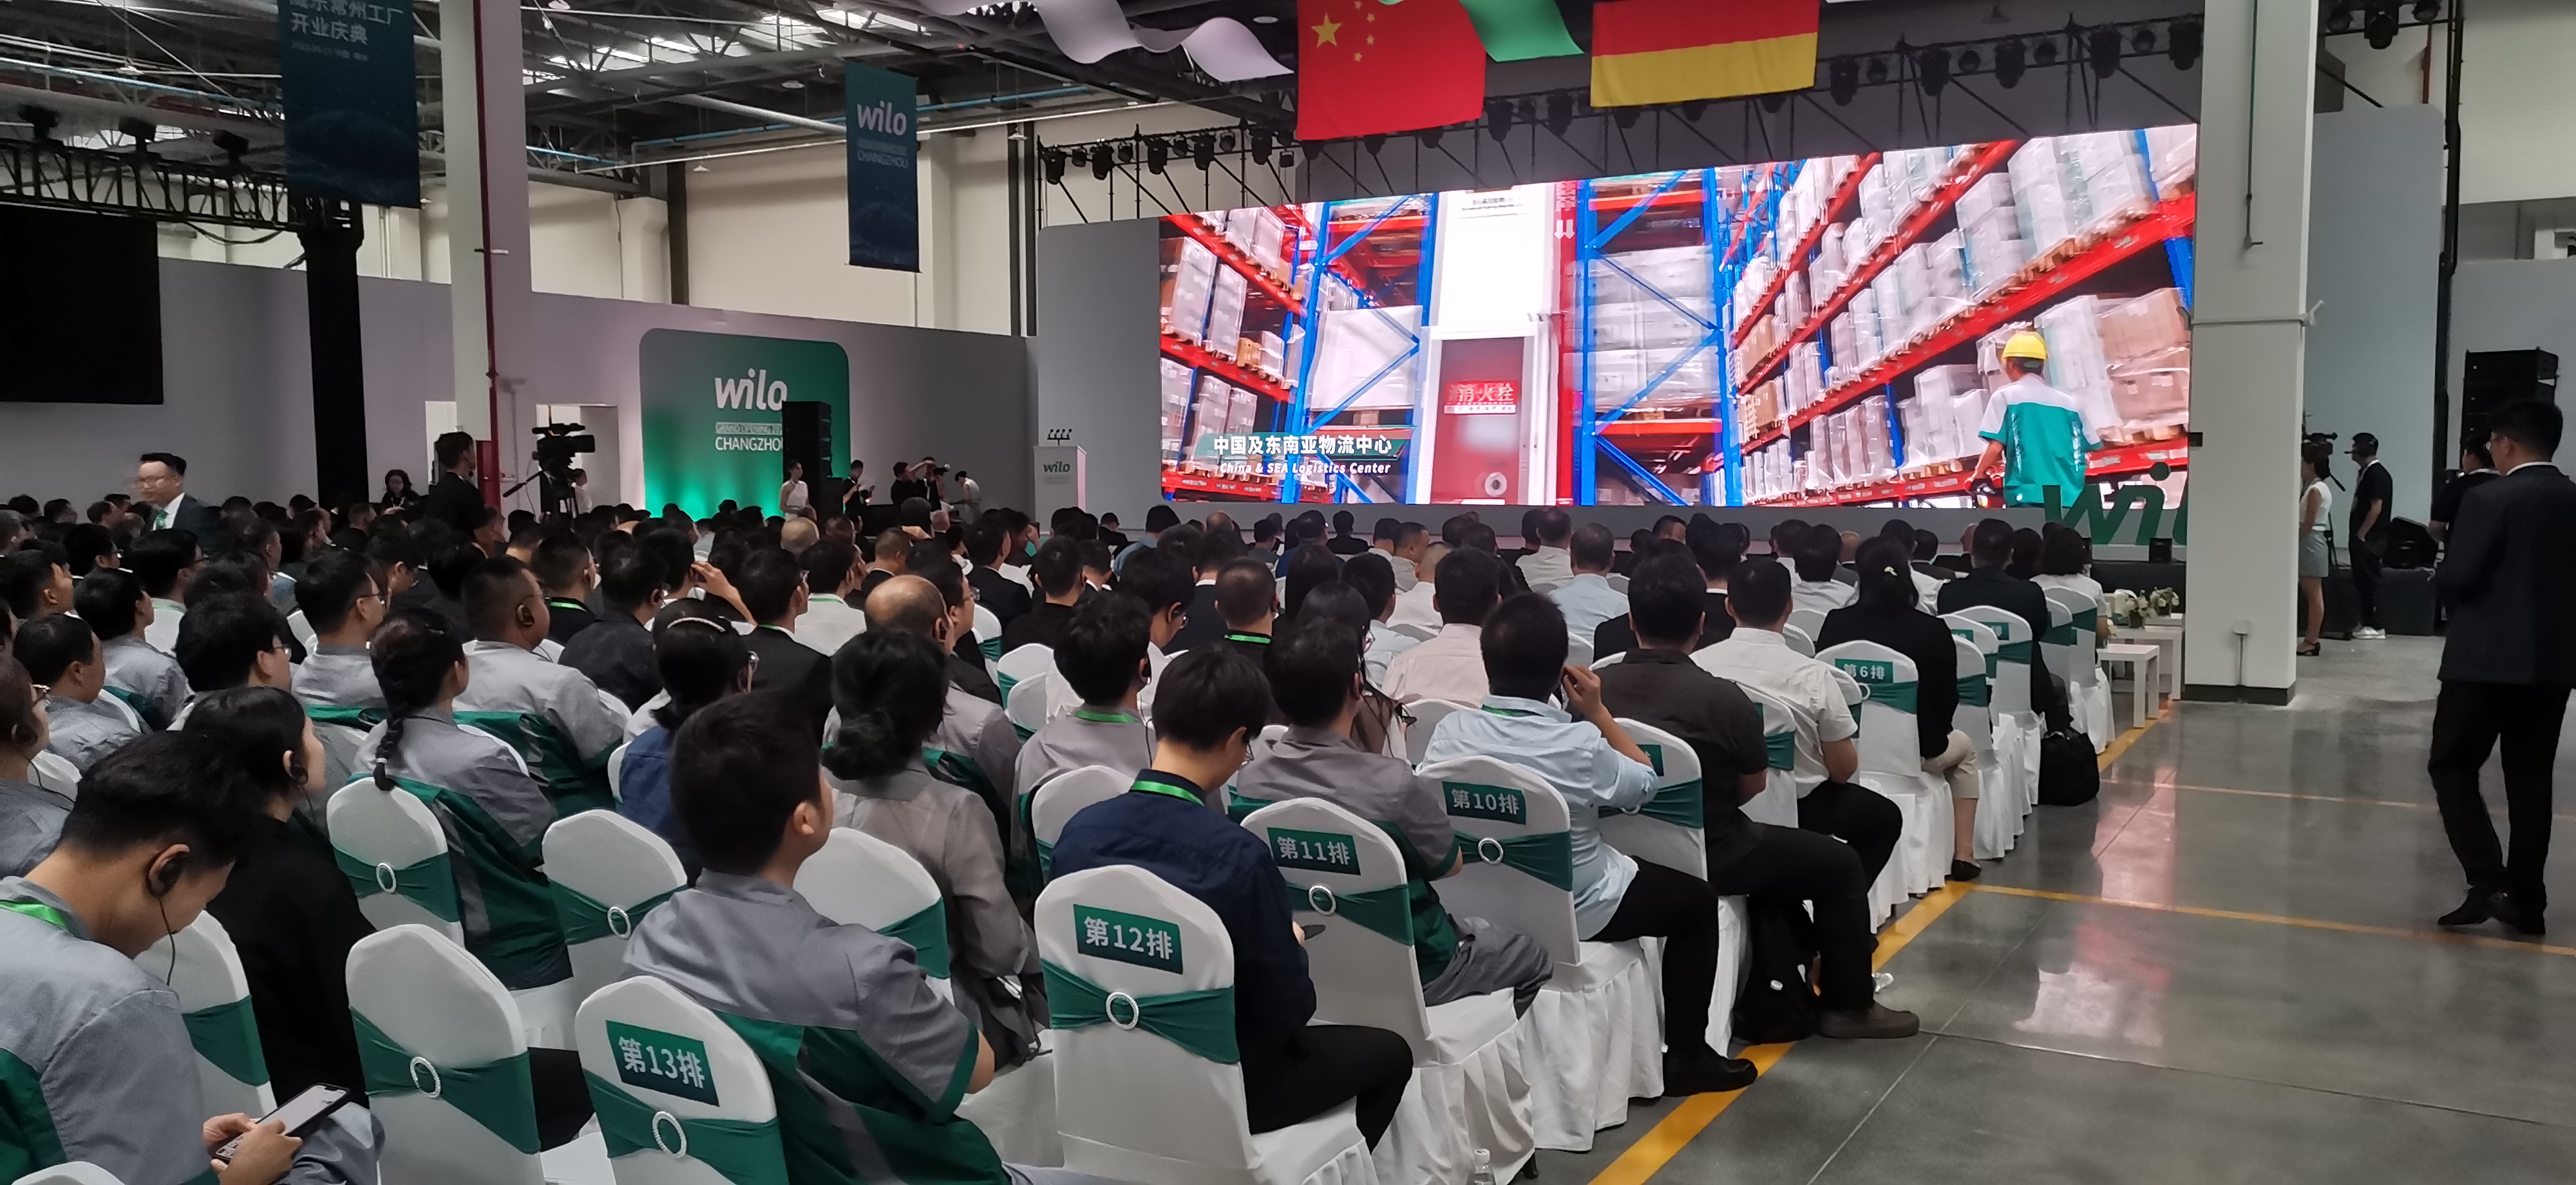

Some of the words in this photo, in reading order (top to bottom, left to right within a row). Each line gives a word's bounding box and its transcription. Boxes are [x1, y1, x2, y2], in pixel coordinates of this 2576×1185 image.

[290, 12, 368, 46] 开业庆典
[857, 99, 907, 136] wilo
[715, 368, 788, 411] wilo
[1213, 434, 1392, 455] 中国及东南亚物流中心
[1043, 460, 1070, 473] wilo
[1220, 462, 1251, 473] China
[1255, 463, 1263, 473] &
[1267, 462, 1288, 473] SEA
[1292, 462, 1346, 475] Logistics
[1349, 462, 1392, 474] Center
[1451, 789, 1520, 816] 第10排
[1276, 836, 1351, 866] 第11排
[1083, 916, 1173, 960] 第12排
[618, 1036, 705, 1089] 第13排
